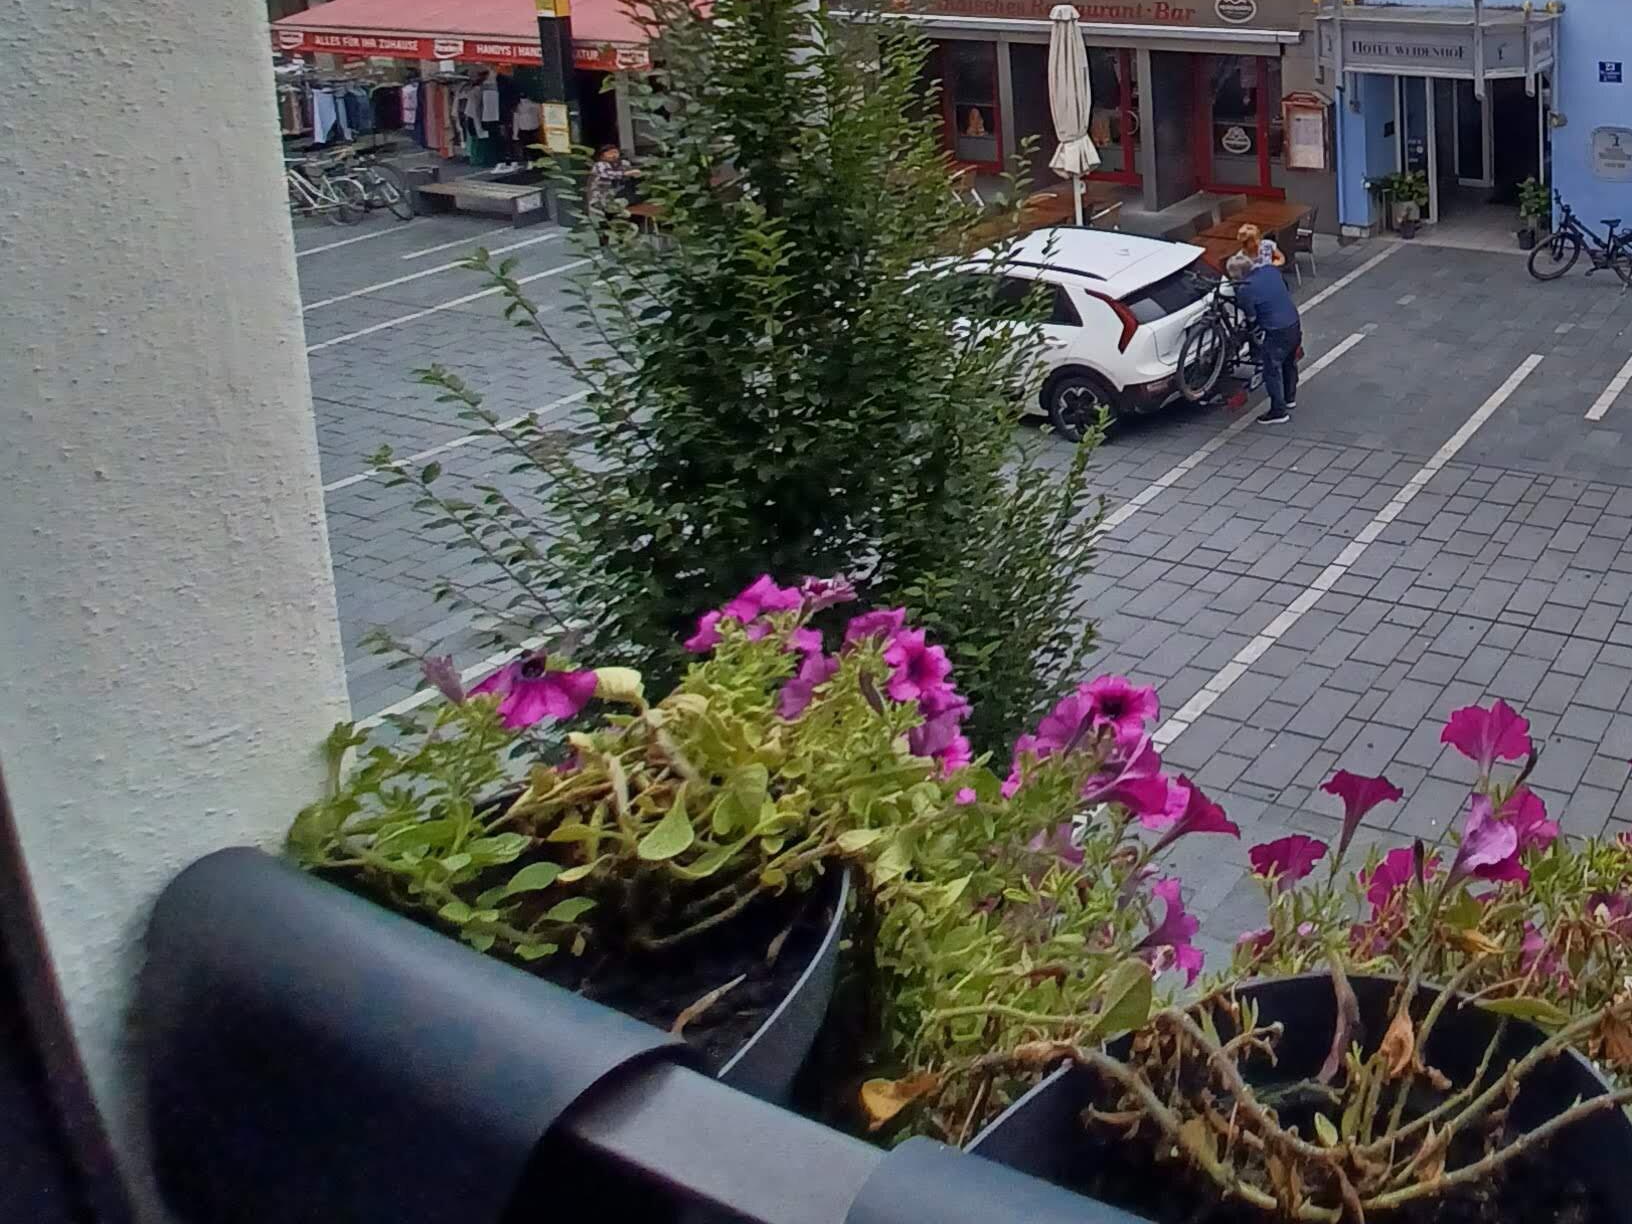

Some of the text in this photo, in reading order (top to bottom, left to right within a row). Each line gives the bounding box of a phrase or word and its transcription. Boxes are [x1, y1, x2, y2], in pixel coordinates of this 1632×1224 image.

[1152, 1, 1195, 24] Bar
[315, 34, 341, 46] ALLES
[342, 36, 360, 47] FÜR
[378, 38, 419, 51] ZUHAUSE
[476, 44, 512, 57] HANDYS
[1352, 40, 1465, 60] HOTEL WEIDENHOF
